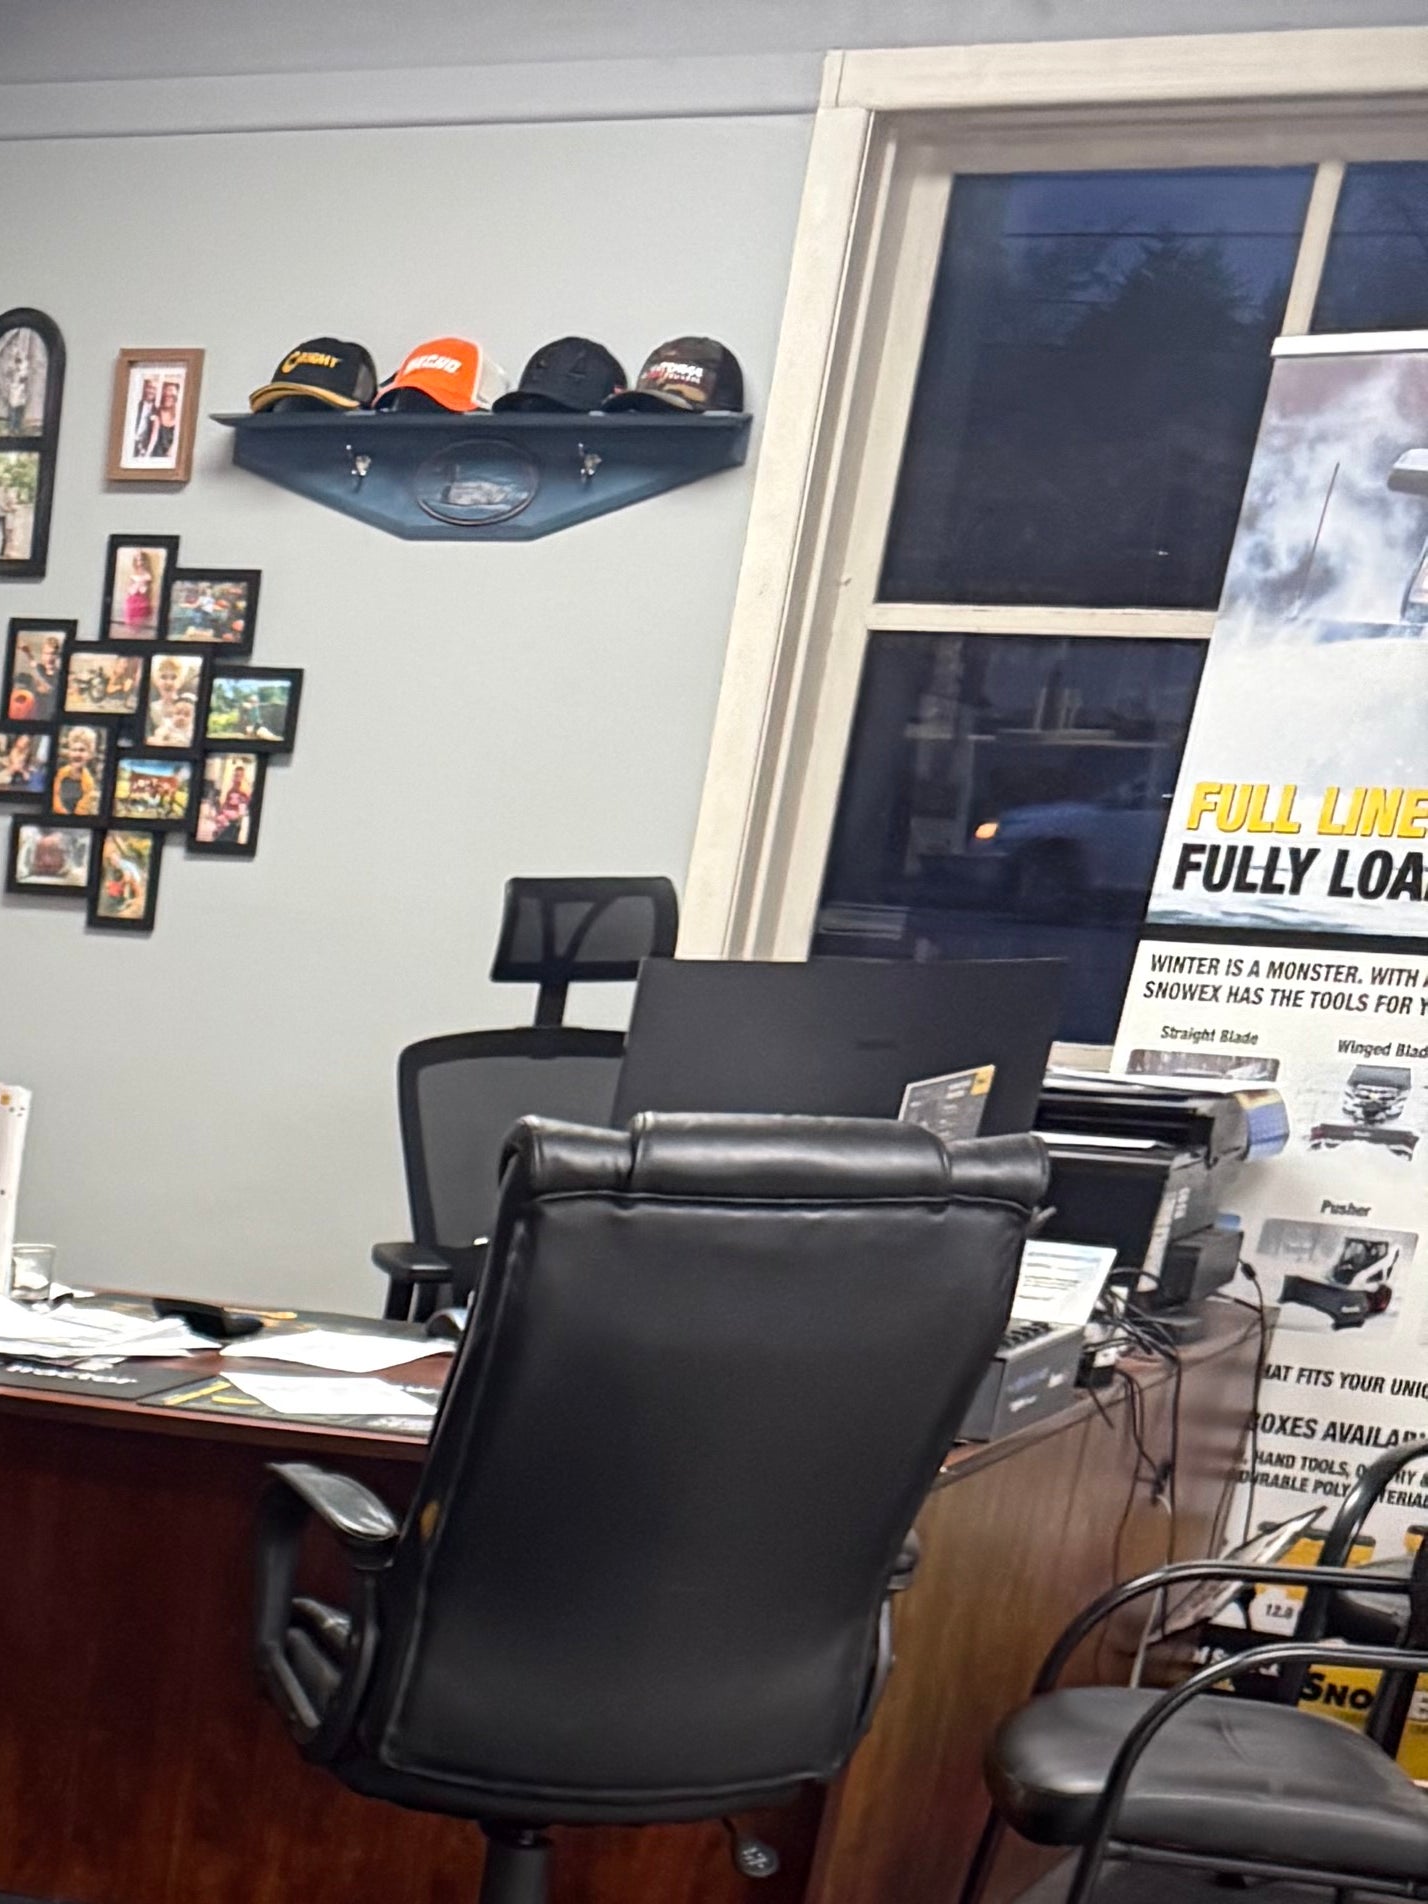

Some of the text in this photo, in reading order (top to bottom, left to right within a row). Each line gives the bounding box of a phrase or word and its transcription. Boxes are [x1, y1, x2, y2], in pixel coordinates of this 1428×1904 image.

[1187, 781, 1428, 839] FULL LINE
[1173, 842, 1428, 900] FULLY LOA
[1150, 954, 1416, 988] WINTER IS A MONSTER. WITH
[1143, 981, 1220, 1004] SNOWEX
[1226, 986, 1263, 1006] HAS
[1269, 989, 1303, 1009] THE
[1309, 990, 1368, 1013] TOOLS
[1373, 994, 1412, 1015] FOR
[1160, 1025, 1258, 1045] Straight Blade
[1338, 1039, 1391, 1058] Winged
[1321, 1200, 1372, 1218] Pusher
[1295, 1368, 1334, 1388] FITS
[1340, 1372, 1385, 1393] YOUR
[1254, 1450, 1295, 1469] HAND
[1301, 1456, 1351, 1479] TOOLS,
[1312, 1480, 1352, 1498] POLY
